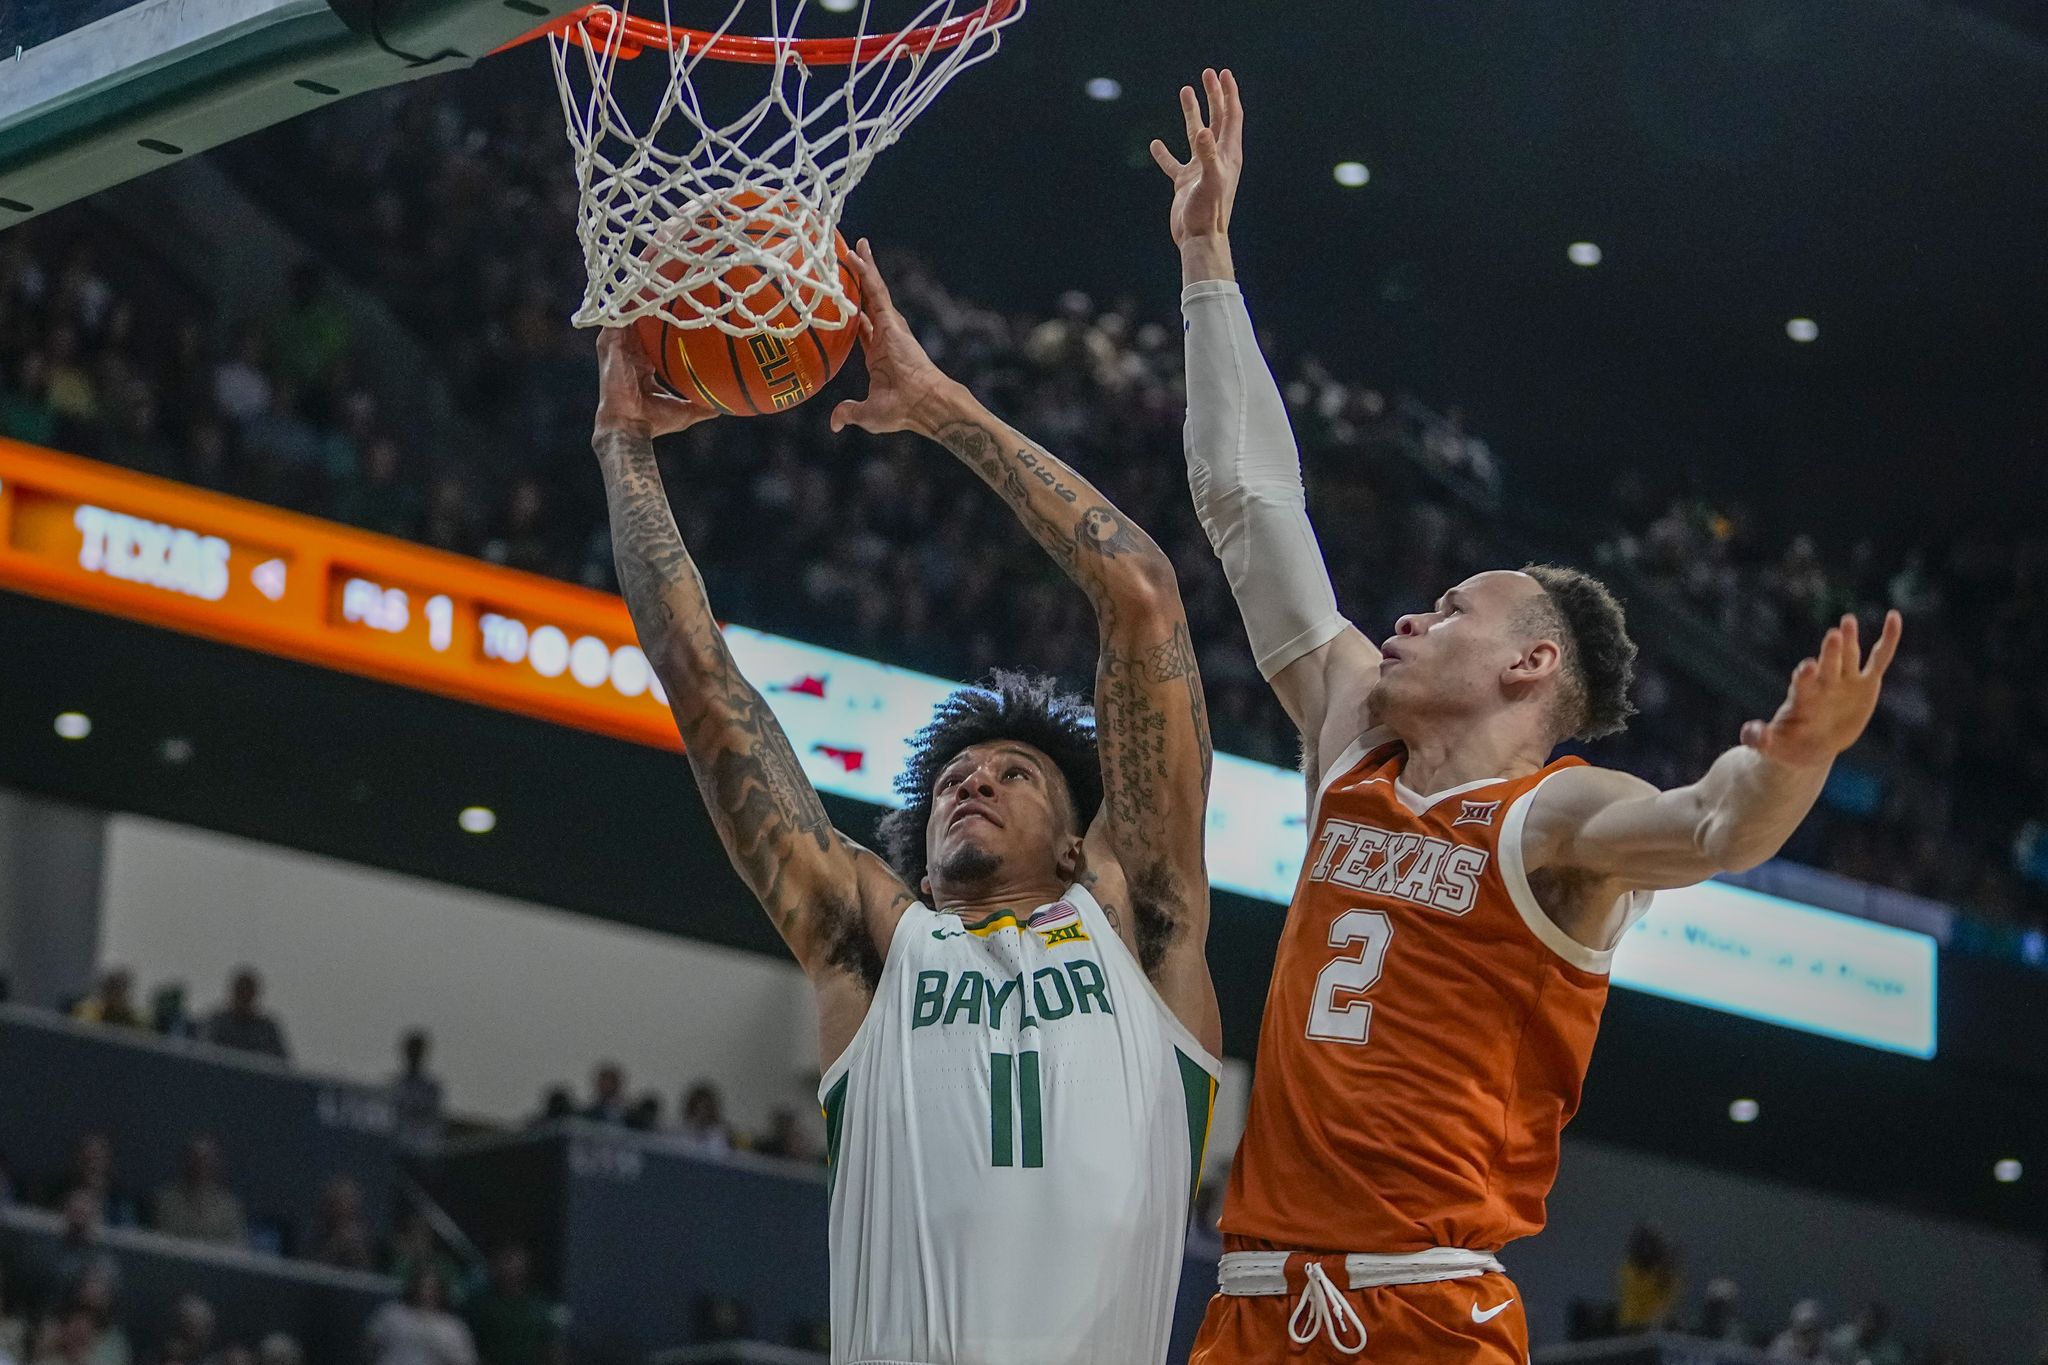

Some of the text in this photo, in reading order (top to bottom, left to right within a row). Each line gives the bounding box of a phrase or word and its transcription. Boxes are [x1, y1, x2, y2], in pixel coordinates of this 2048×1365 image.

[73, 504, 231, 601] TEXAS
[425, 595, 453, 652] 1
[1309, 818, 1489, 917] TEXAS
[912, 959, 1113, 1031] BAYLOR
[1305, 908, 1394, 1045] 2
[990, 1051, 1043, 1168] 11
